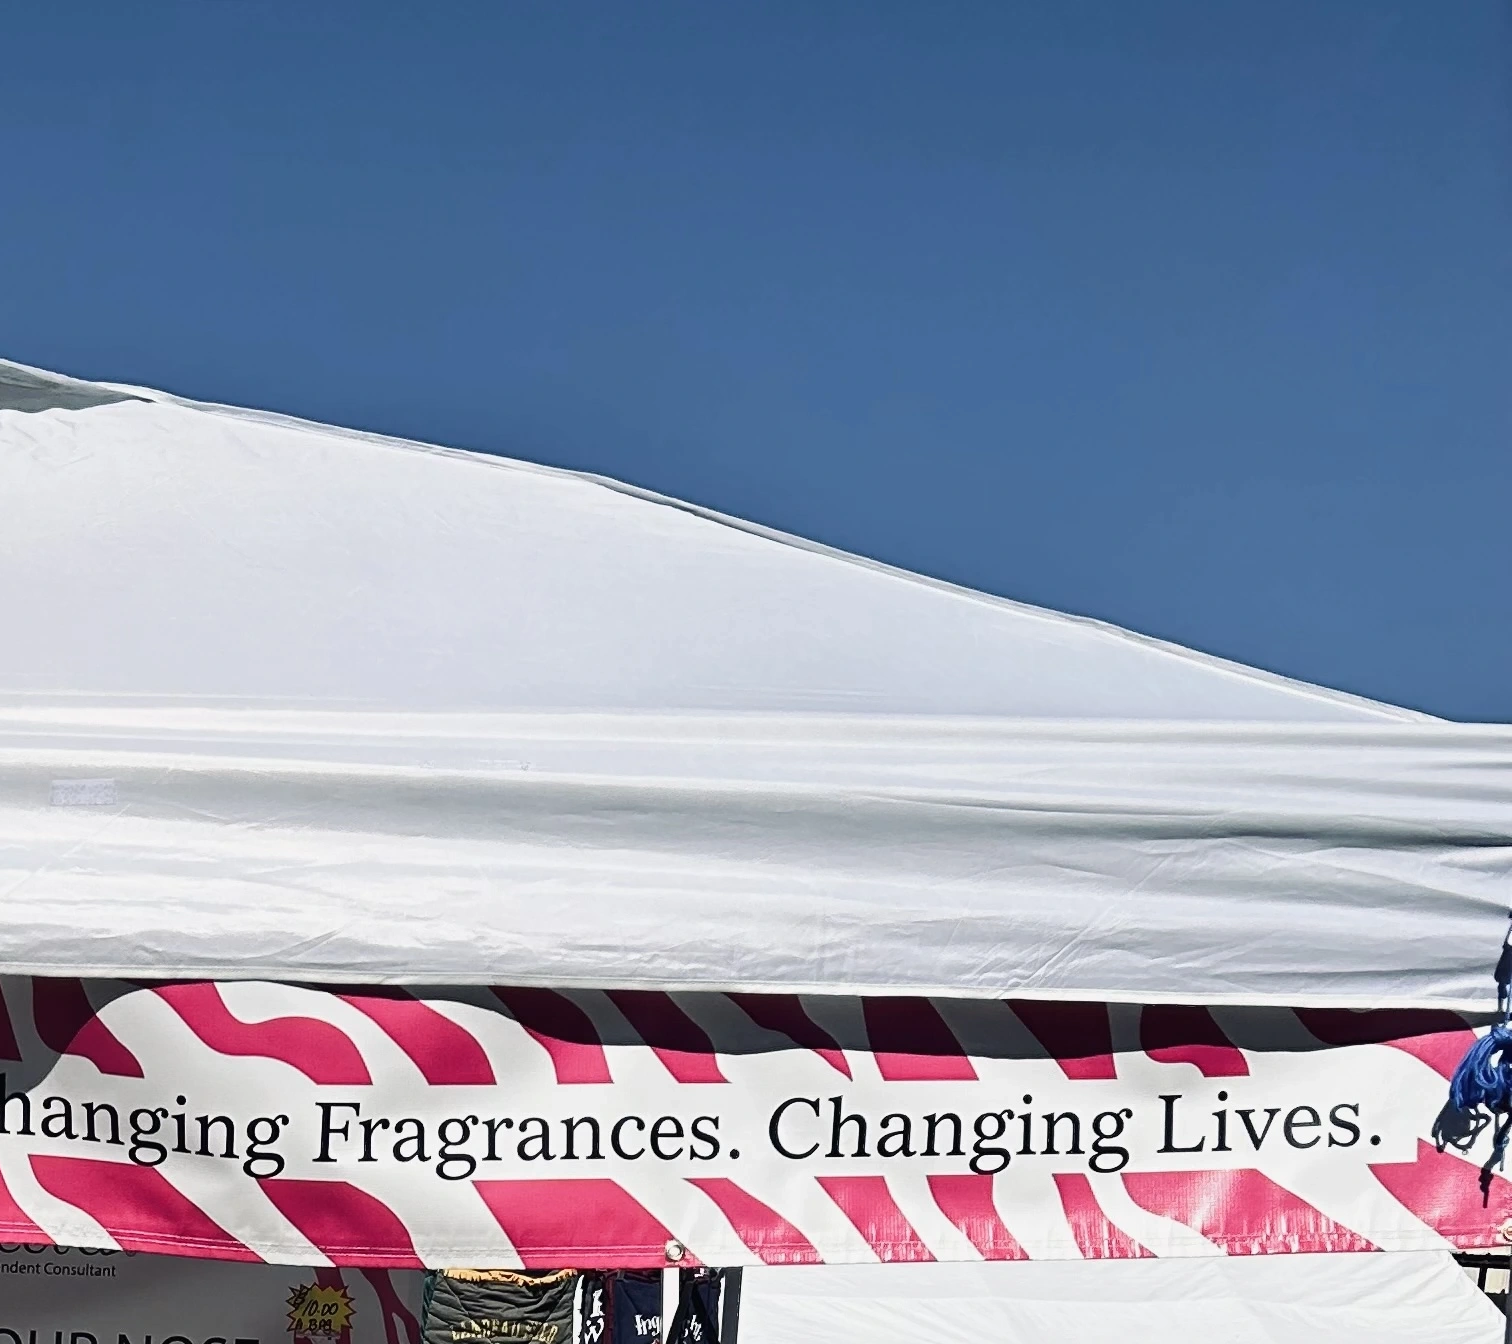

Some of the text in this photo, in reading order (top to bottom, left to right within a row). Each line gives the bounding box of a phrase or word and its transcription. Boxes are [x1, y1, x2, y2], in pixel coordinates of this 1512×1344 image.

[311, 1100, 741, 1181] Fragrances.
[767, 1094, 1133, 1175] Changing
[1156, 1091, 1383, 1154] Lives.
[43, 1260, 117, 1277] Consultant
